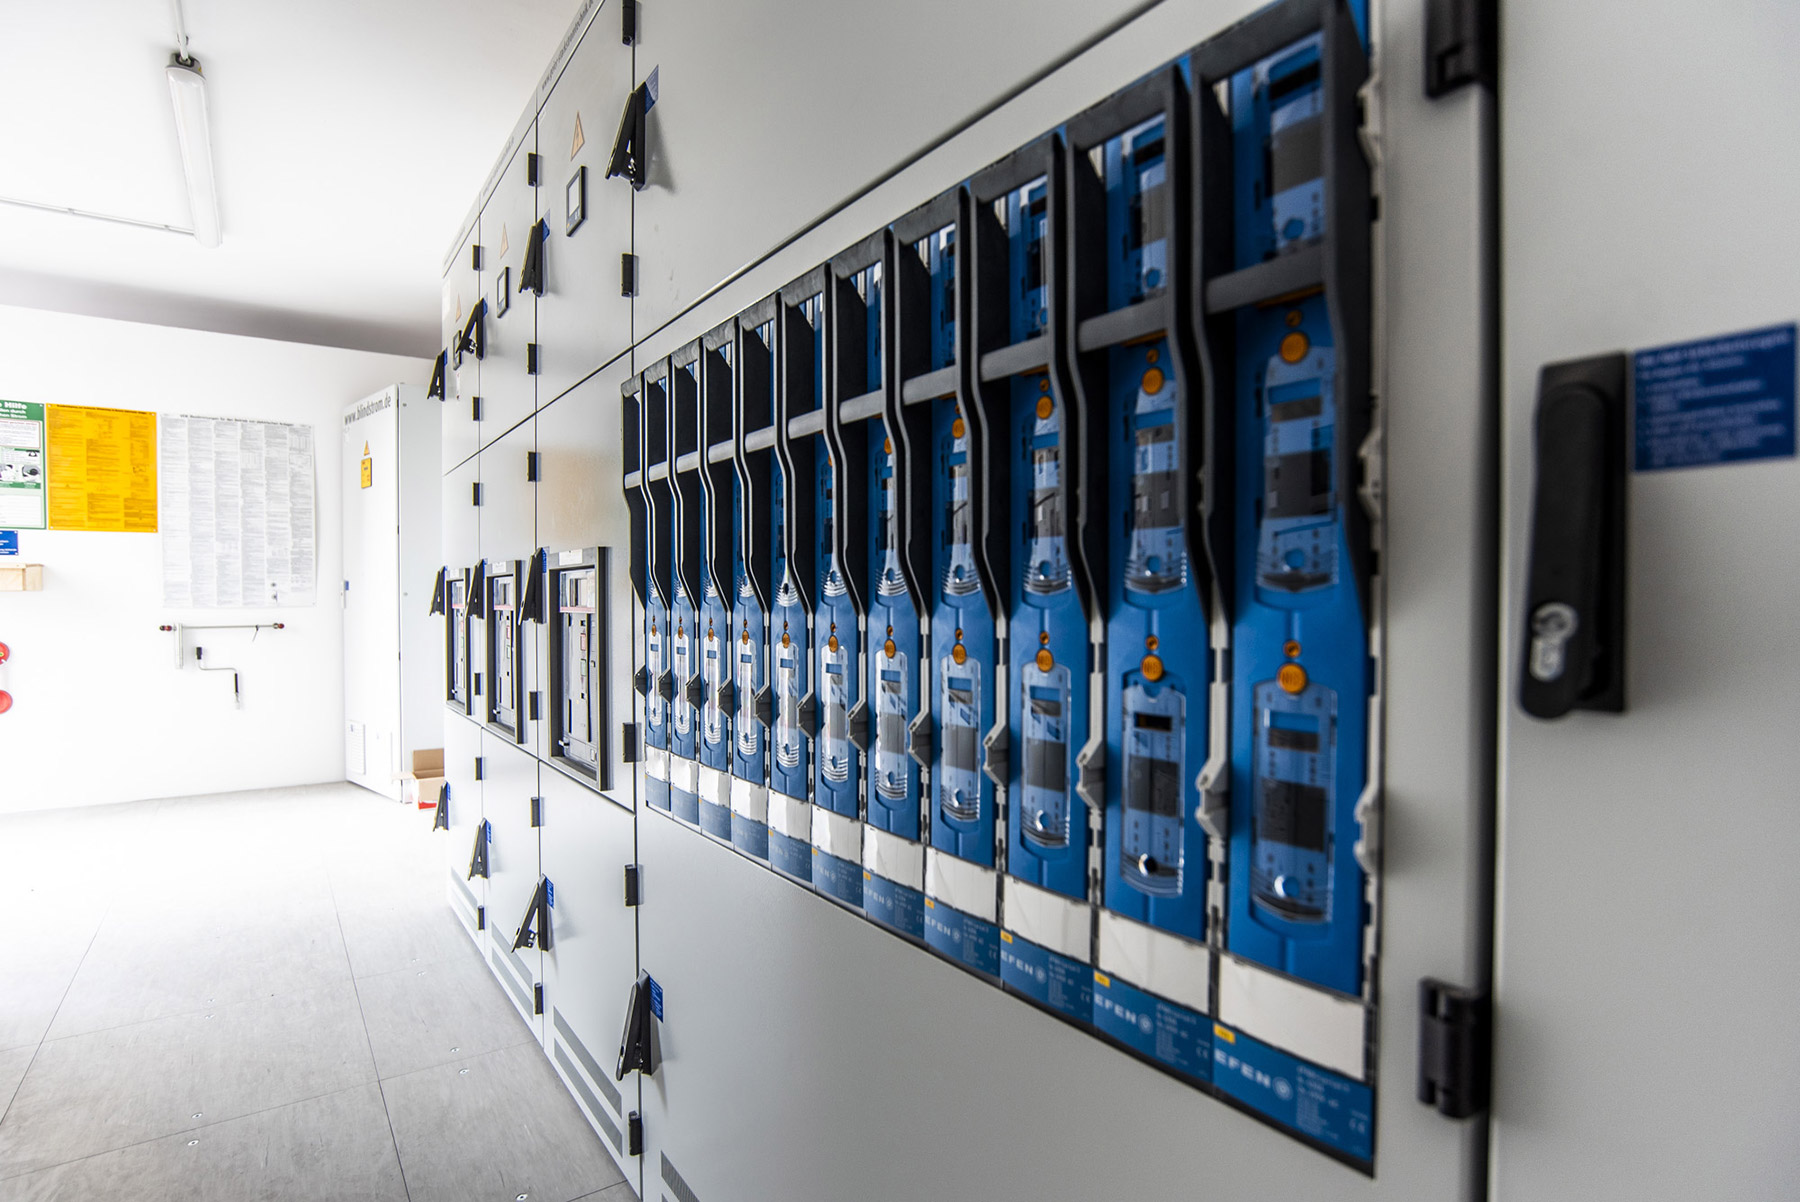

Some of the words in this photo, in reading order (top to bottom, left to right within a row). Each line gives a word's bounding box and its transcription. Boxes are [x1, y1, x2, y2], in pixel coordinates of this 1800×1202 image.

[4, 401, 28, 410] Hilfe
[344, 393, 392, 425] www.blindstrom.de
[924, 914, 951, 936] EFEN
[1000, 949, 1034, 976] EFEN
[1093, 993, 1137, 1025] EFEN
[1213, 1047, 1271, 1089] EFEN
